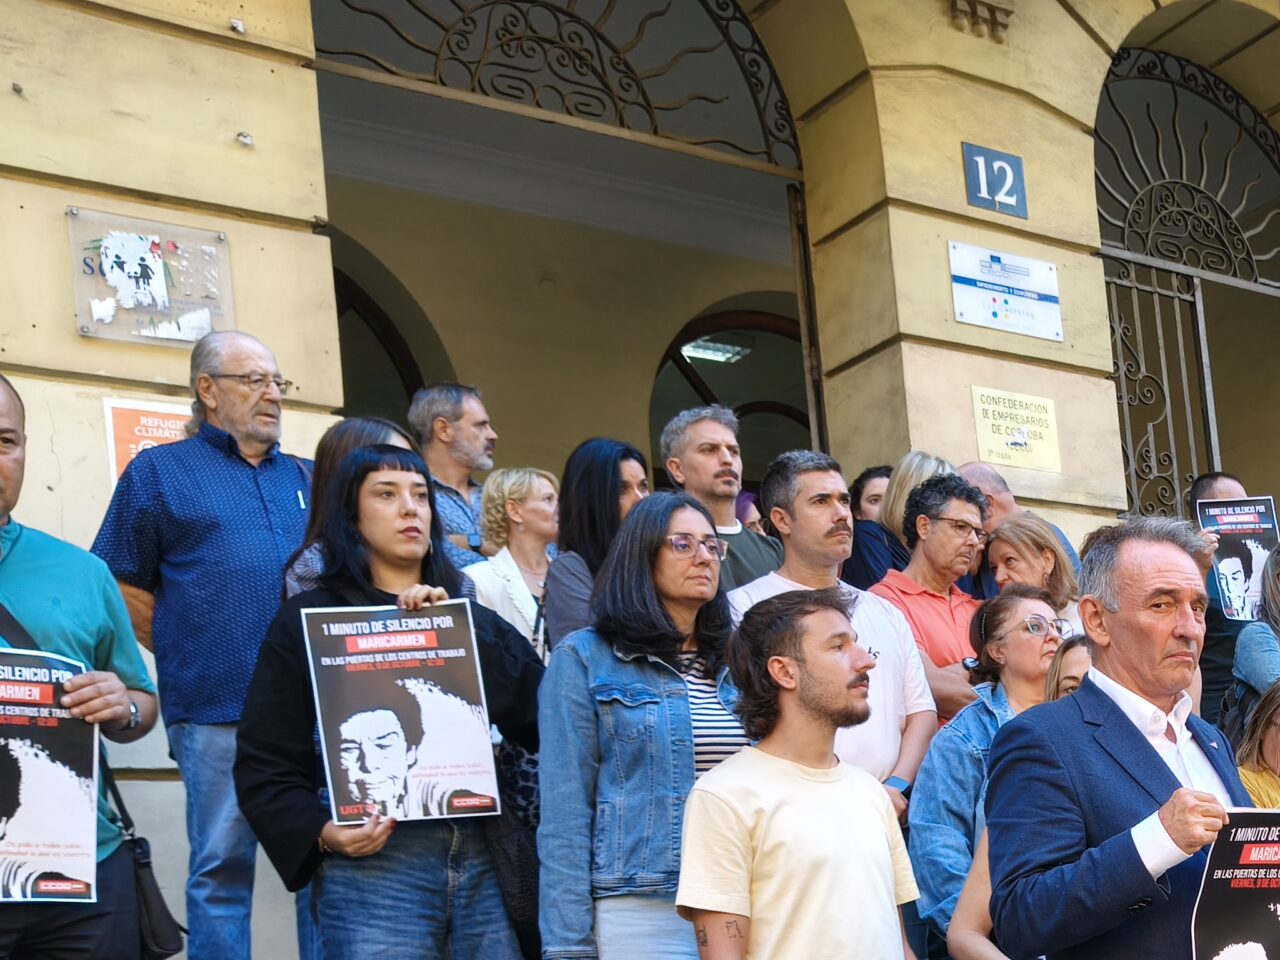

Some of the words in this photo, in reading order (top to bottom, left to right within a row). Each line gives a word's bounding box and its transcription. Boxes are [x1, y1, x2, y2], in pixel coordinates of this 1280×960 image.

[973, 156, 1016, 206] 12
[980, 394, 1048, 415] CONFEDERACION
[982, 408, 990, 419] DE
[992, 410, 1049, 428] EMPRESARIOS
[991, 424, 1003, 435] DE
[322, 624, 329, 636] 1
[329, 621, 370, 635] MINUTO
[371, 619, 385, 632] DE
[387, 617, 431, 631] SILENCIO
[433, 615, 454, 629] POR
[357, 633, 427, 649] MARICARMEN
[0, 665, 50, 682] SILENCIO
[0, 683, 40, 700] ARMEN
[340, 804, 365, 816] UGT
[1229, 828, 1236, 842] 1
[1235, 827, 1269, 842] MINUTO
[1269, 827, 1280, 841] DE
[1213, 870, 1221, 879] EN
[1221, 870, 1233, 879] LAS
[1233, 869, 1258, 879] PUERTAS
[1258, 869, 1266, 879] DE
[1266, 869, 1277, 879] LOS
